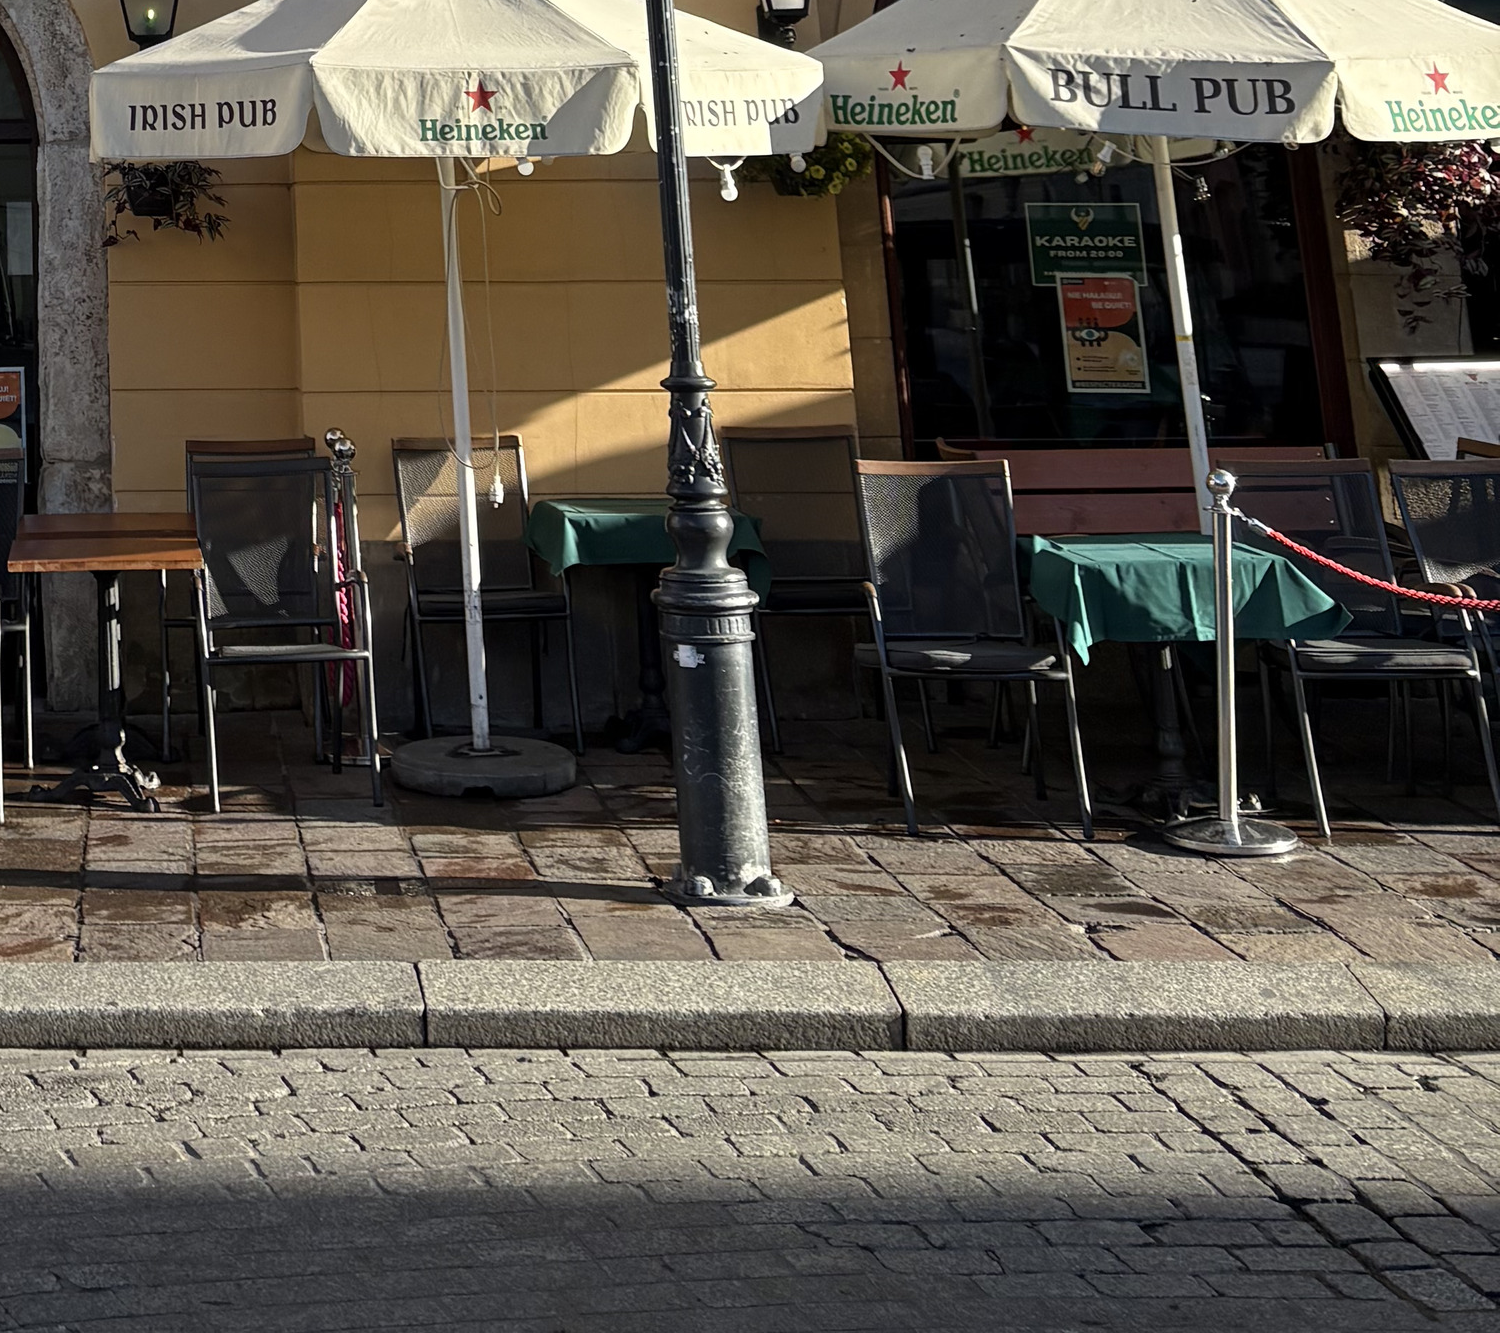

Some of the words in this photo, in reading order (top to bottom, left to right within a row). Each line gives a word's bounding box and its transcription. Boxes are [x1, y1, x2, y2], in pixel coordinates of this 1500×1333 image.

[1047, 67, 1177, 111] BULL
[1190, 77, 1296, 115] PUB
[128, 103, 206, 131] IRISH
[216, 98, 277, 129] PUB
[680, 100, 737, 127] RISH
[743, 98, 800, 125] PUB
[830, 94, 958, 125] Heineken
[1384, 99, 1500, 132] Heineke
[418, 118, 548, 142] Heineken
[966, 145, 1094, 173] Heineken
[1035, 236, 1137, 247] KARAOKE
[1049, 250, 1087, 258] FROM
